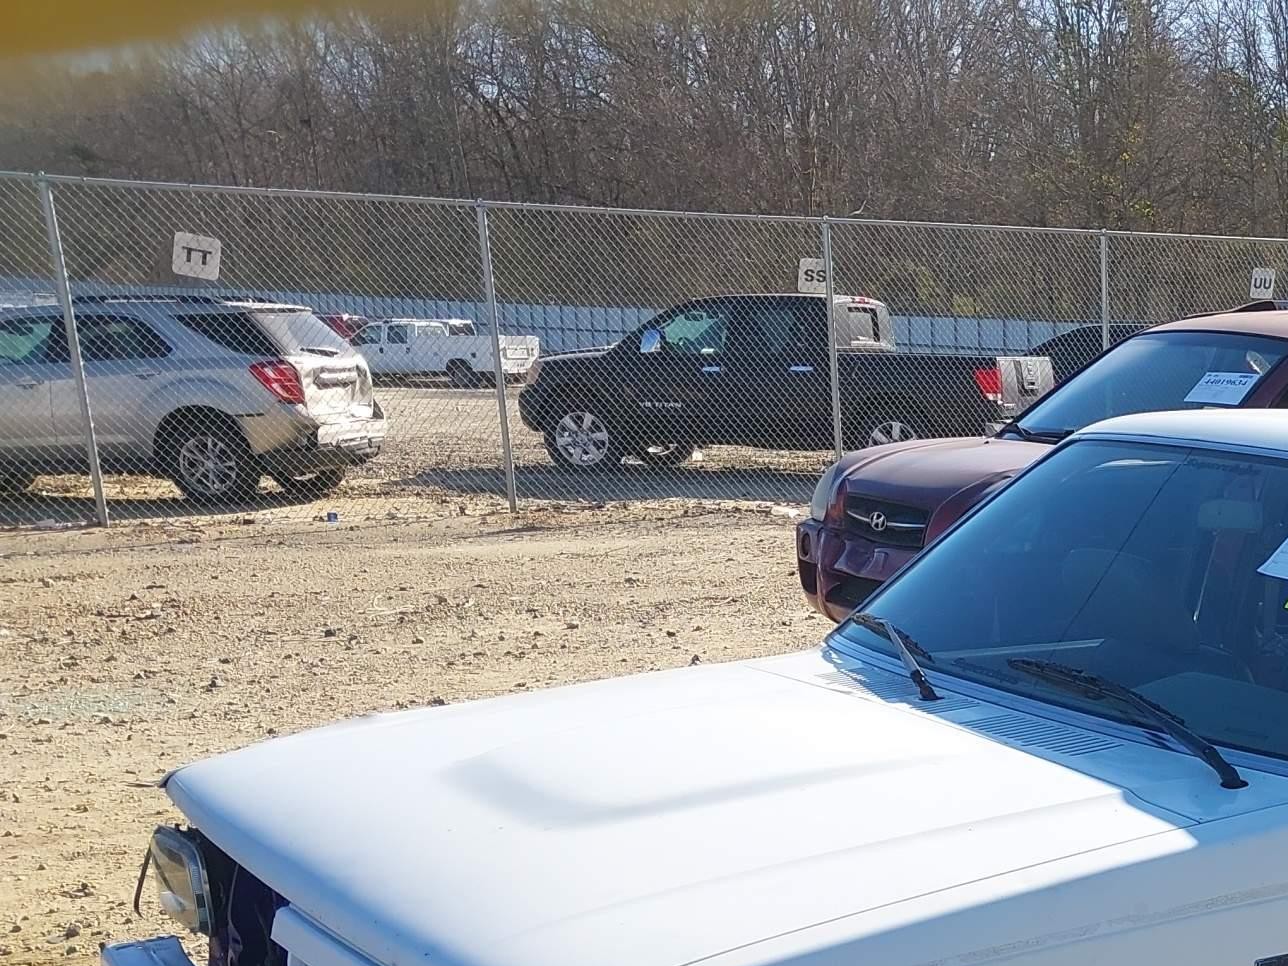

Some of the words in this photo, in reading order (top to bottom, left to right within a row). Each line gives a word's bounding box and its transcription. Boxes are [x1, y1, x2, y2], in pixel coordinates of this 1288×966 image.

[182, 246, 212, 266] TT
[803, 268, 826, 283] SS
[1253, 277, 1272, 290] UU
